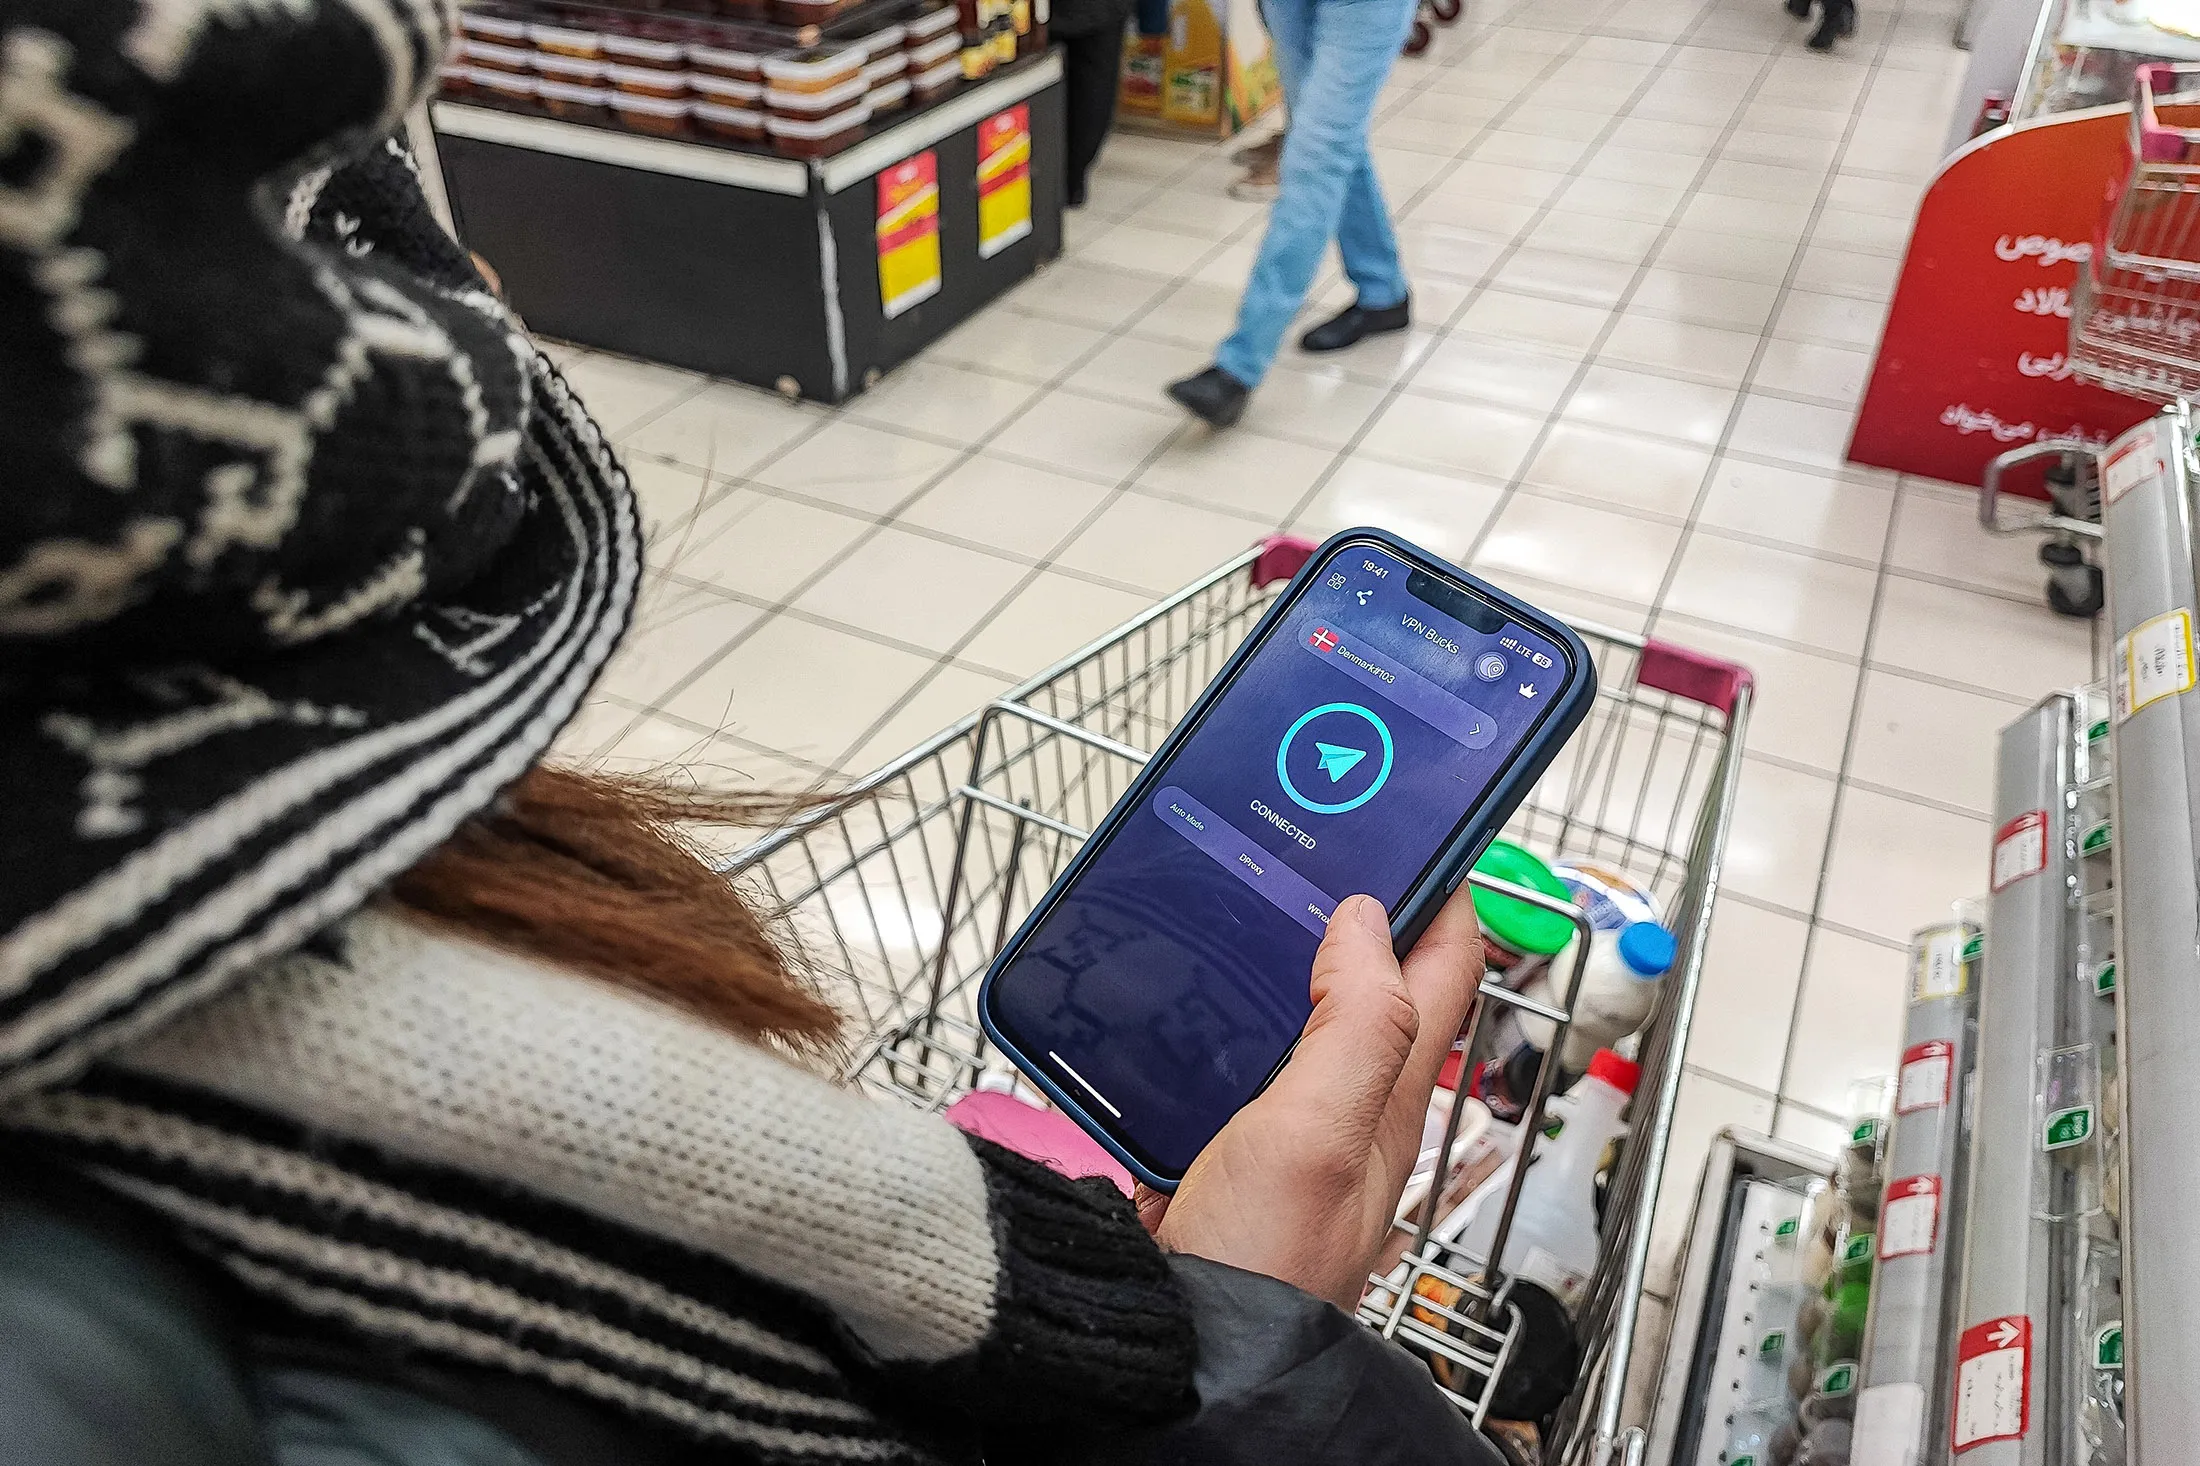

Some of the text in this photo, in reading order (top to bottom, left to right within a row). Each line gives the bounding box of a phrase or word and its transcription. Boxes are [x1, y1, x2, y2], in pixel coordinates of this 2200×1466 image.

[1361, 559, 1389, 580] 19:41
[1400, 613, 1460, 655] VPN Bucks
[1337, 645, 1396, 684] Denmark#103
[1515, 644, 1549, 666] LTE 35
[1170, 802, 1205, 832] Auto Mode
[1250, 799, 1317, 850] CONNECTED
[1238, 853, 1265, 876] DProxy
[1307, 903, 1331, 925] WProx
